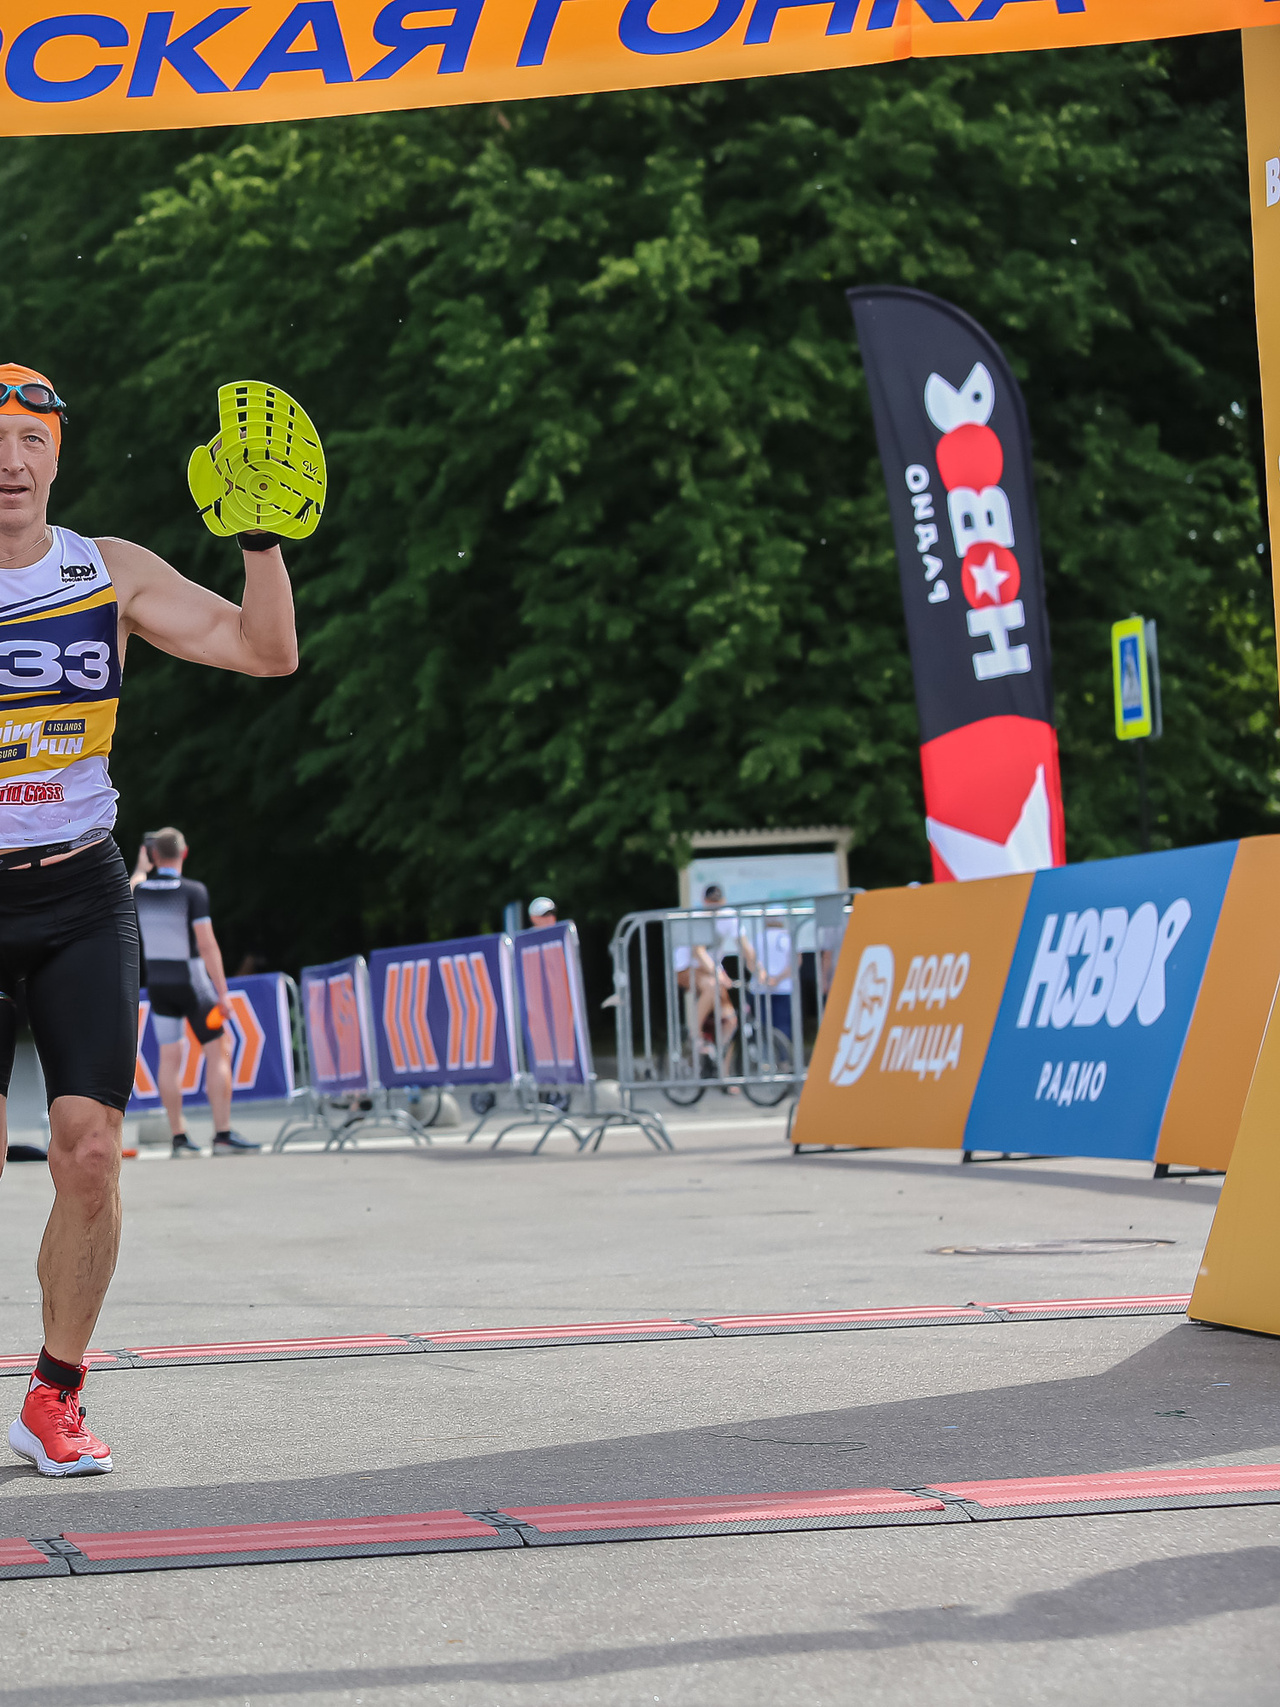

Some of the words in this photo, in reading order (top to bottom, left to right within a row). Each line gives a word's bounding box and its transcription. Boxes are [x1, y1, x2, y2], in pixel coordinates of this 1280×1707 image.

[516, 0, 1086, 67] ГОН
[904, 462, 951, 604] РАДИО
[54, 722, 82, 732] ISLANDS
[24, 784, 62, 803] Class
[896, 952, 971, 1011] ДОДО
[880, 1024, 963, 1082] ПИЦЦА
[1035, 1060, 1107, 1107] РАДИО
